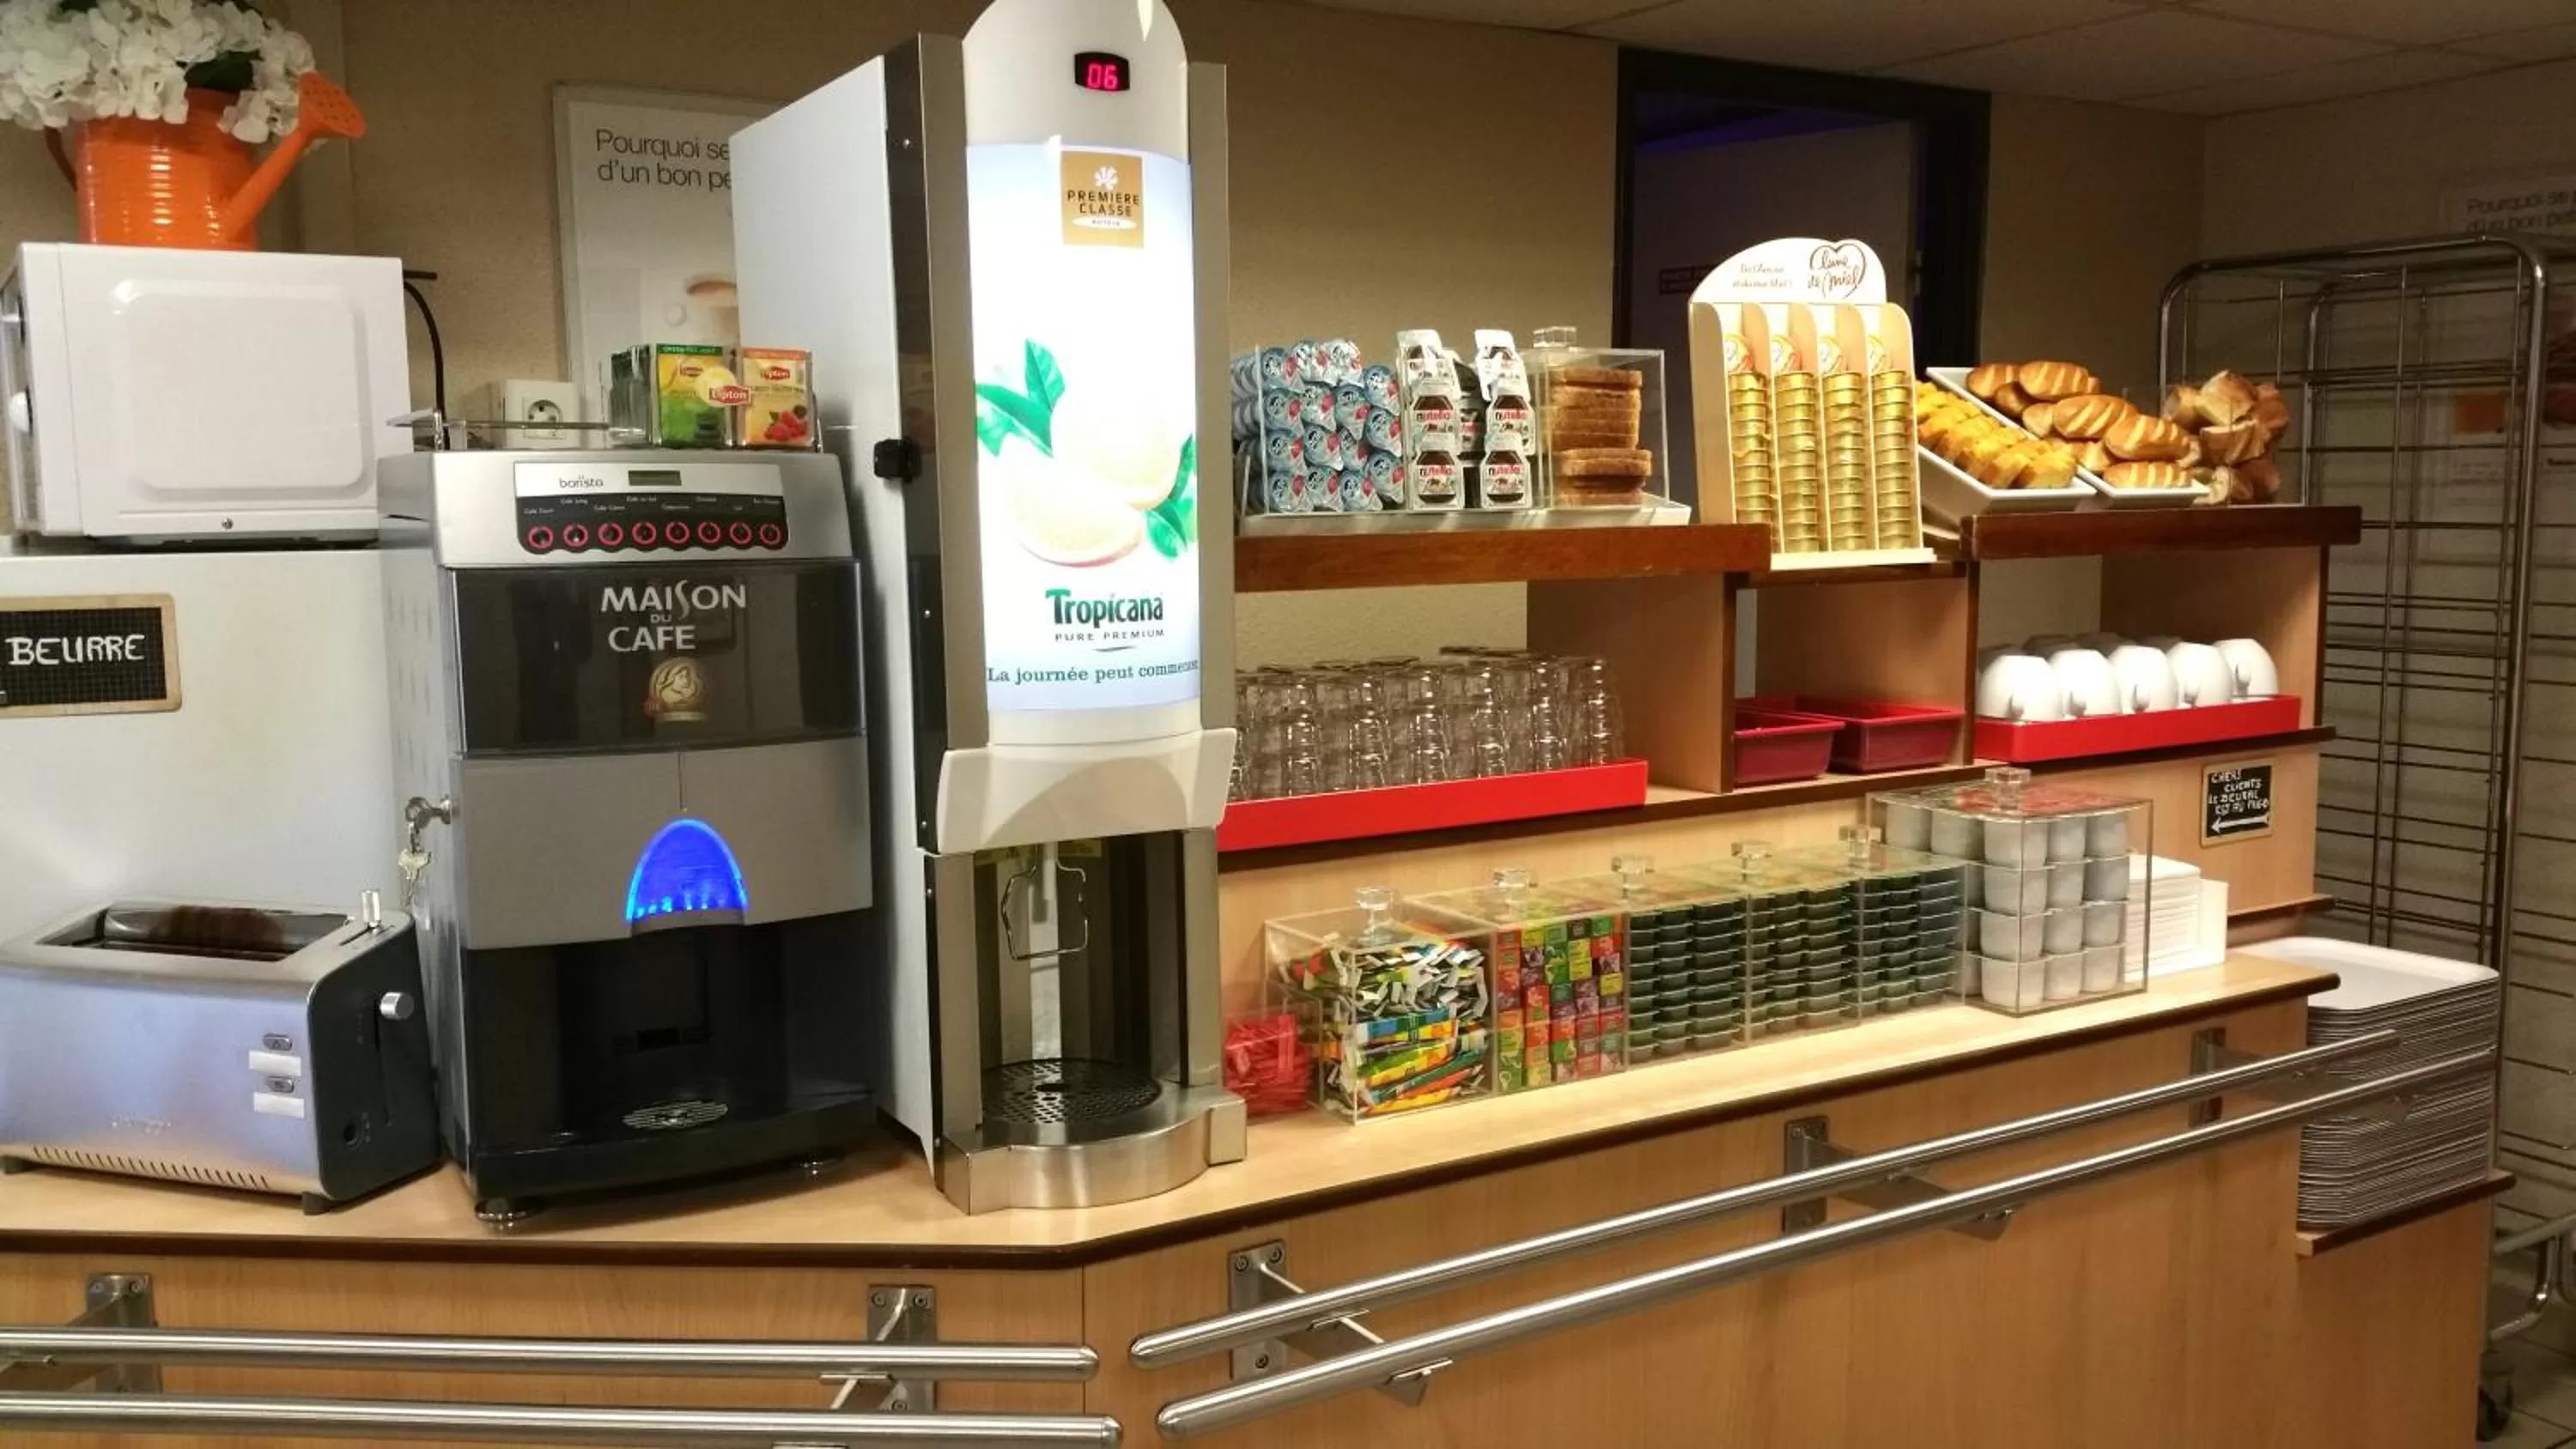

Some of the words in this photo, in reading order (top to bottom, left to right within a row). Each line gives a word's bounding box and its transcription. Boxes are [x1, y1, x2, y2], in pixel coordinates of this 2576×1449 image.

[1087, 64, 1118, 88] 06
[596, 129, 700, 161] Pourquoi
[598, 158, 650, 184] d'un
[657, 163, 702, 185] bon
[1067, 189, 1139, 206] PREMIERE
[1079, 203, 1132, 216] CLASSE
[710, 386, 749, 403] Lipton
[559, 475, 604, 488] barista
[601, 580, 746, 619] MAISON
[1045, 588, 1164, 628] Tropicana
[650, 614, 672, 623] DU
[608, 625, 696, 652] CAFE
[1054, 633, 1095, 642] PURE
[1103, 628, 1164, 640] PREMIUM
[4, 634, 145, 665] BEURRE
[987, 667, 1010, 682] La
[1014, 665, 1089, 685] journée
[1095, 666, 1133, 683] peut
